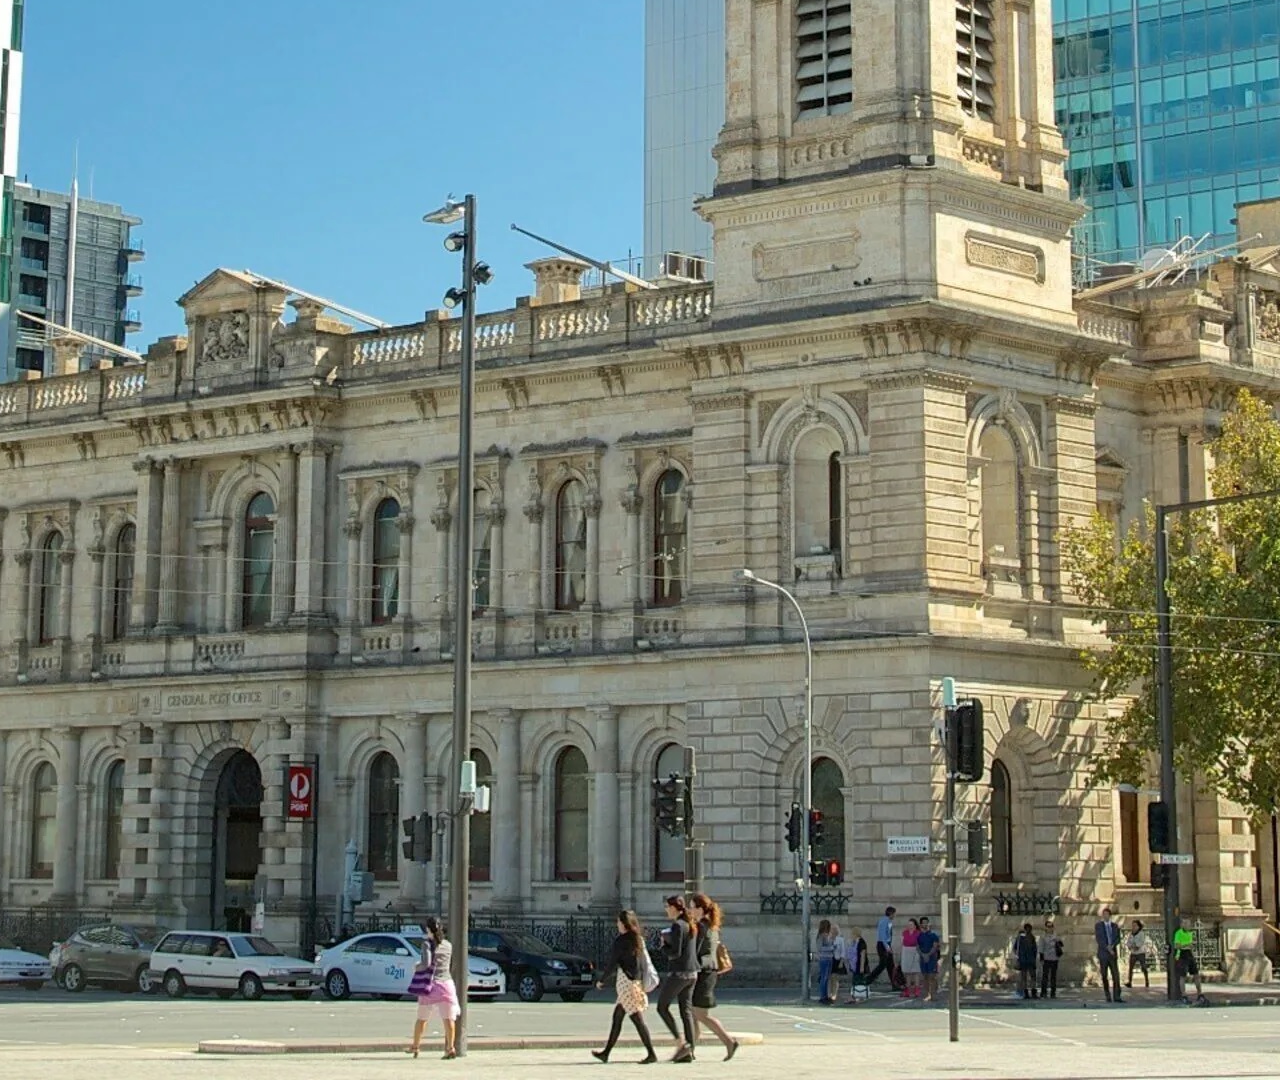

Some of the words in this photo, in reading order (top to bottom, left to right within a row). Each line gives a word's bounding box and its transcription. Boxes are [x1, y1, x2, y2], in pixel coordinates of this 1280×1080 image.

[168, 692, 207, 707] GENERAL
[209, 690, 230, 704] POST
[232, 690, 262, 704] OFFICE
